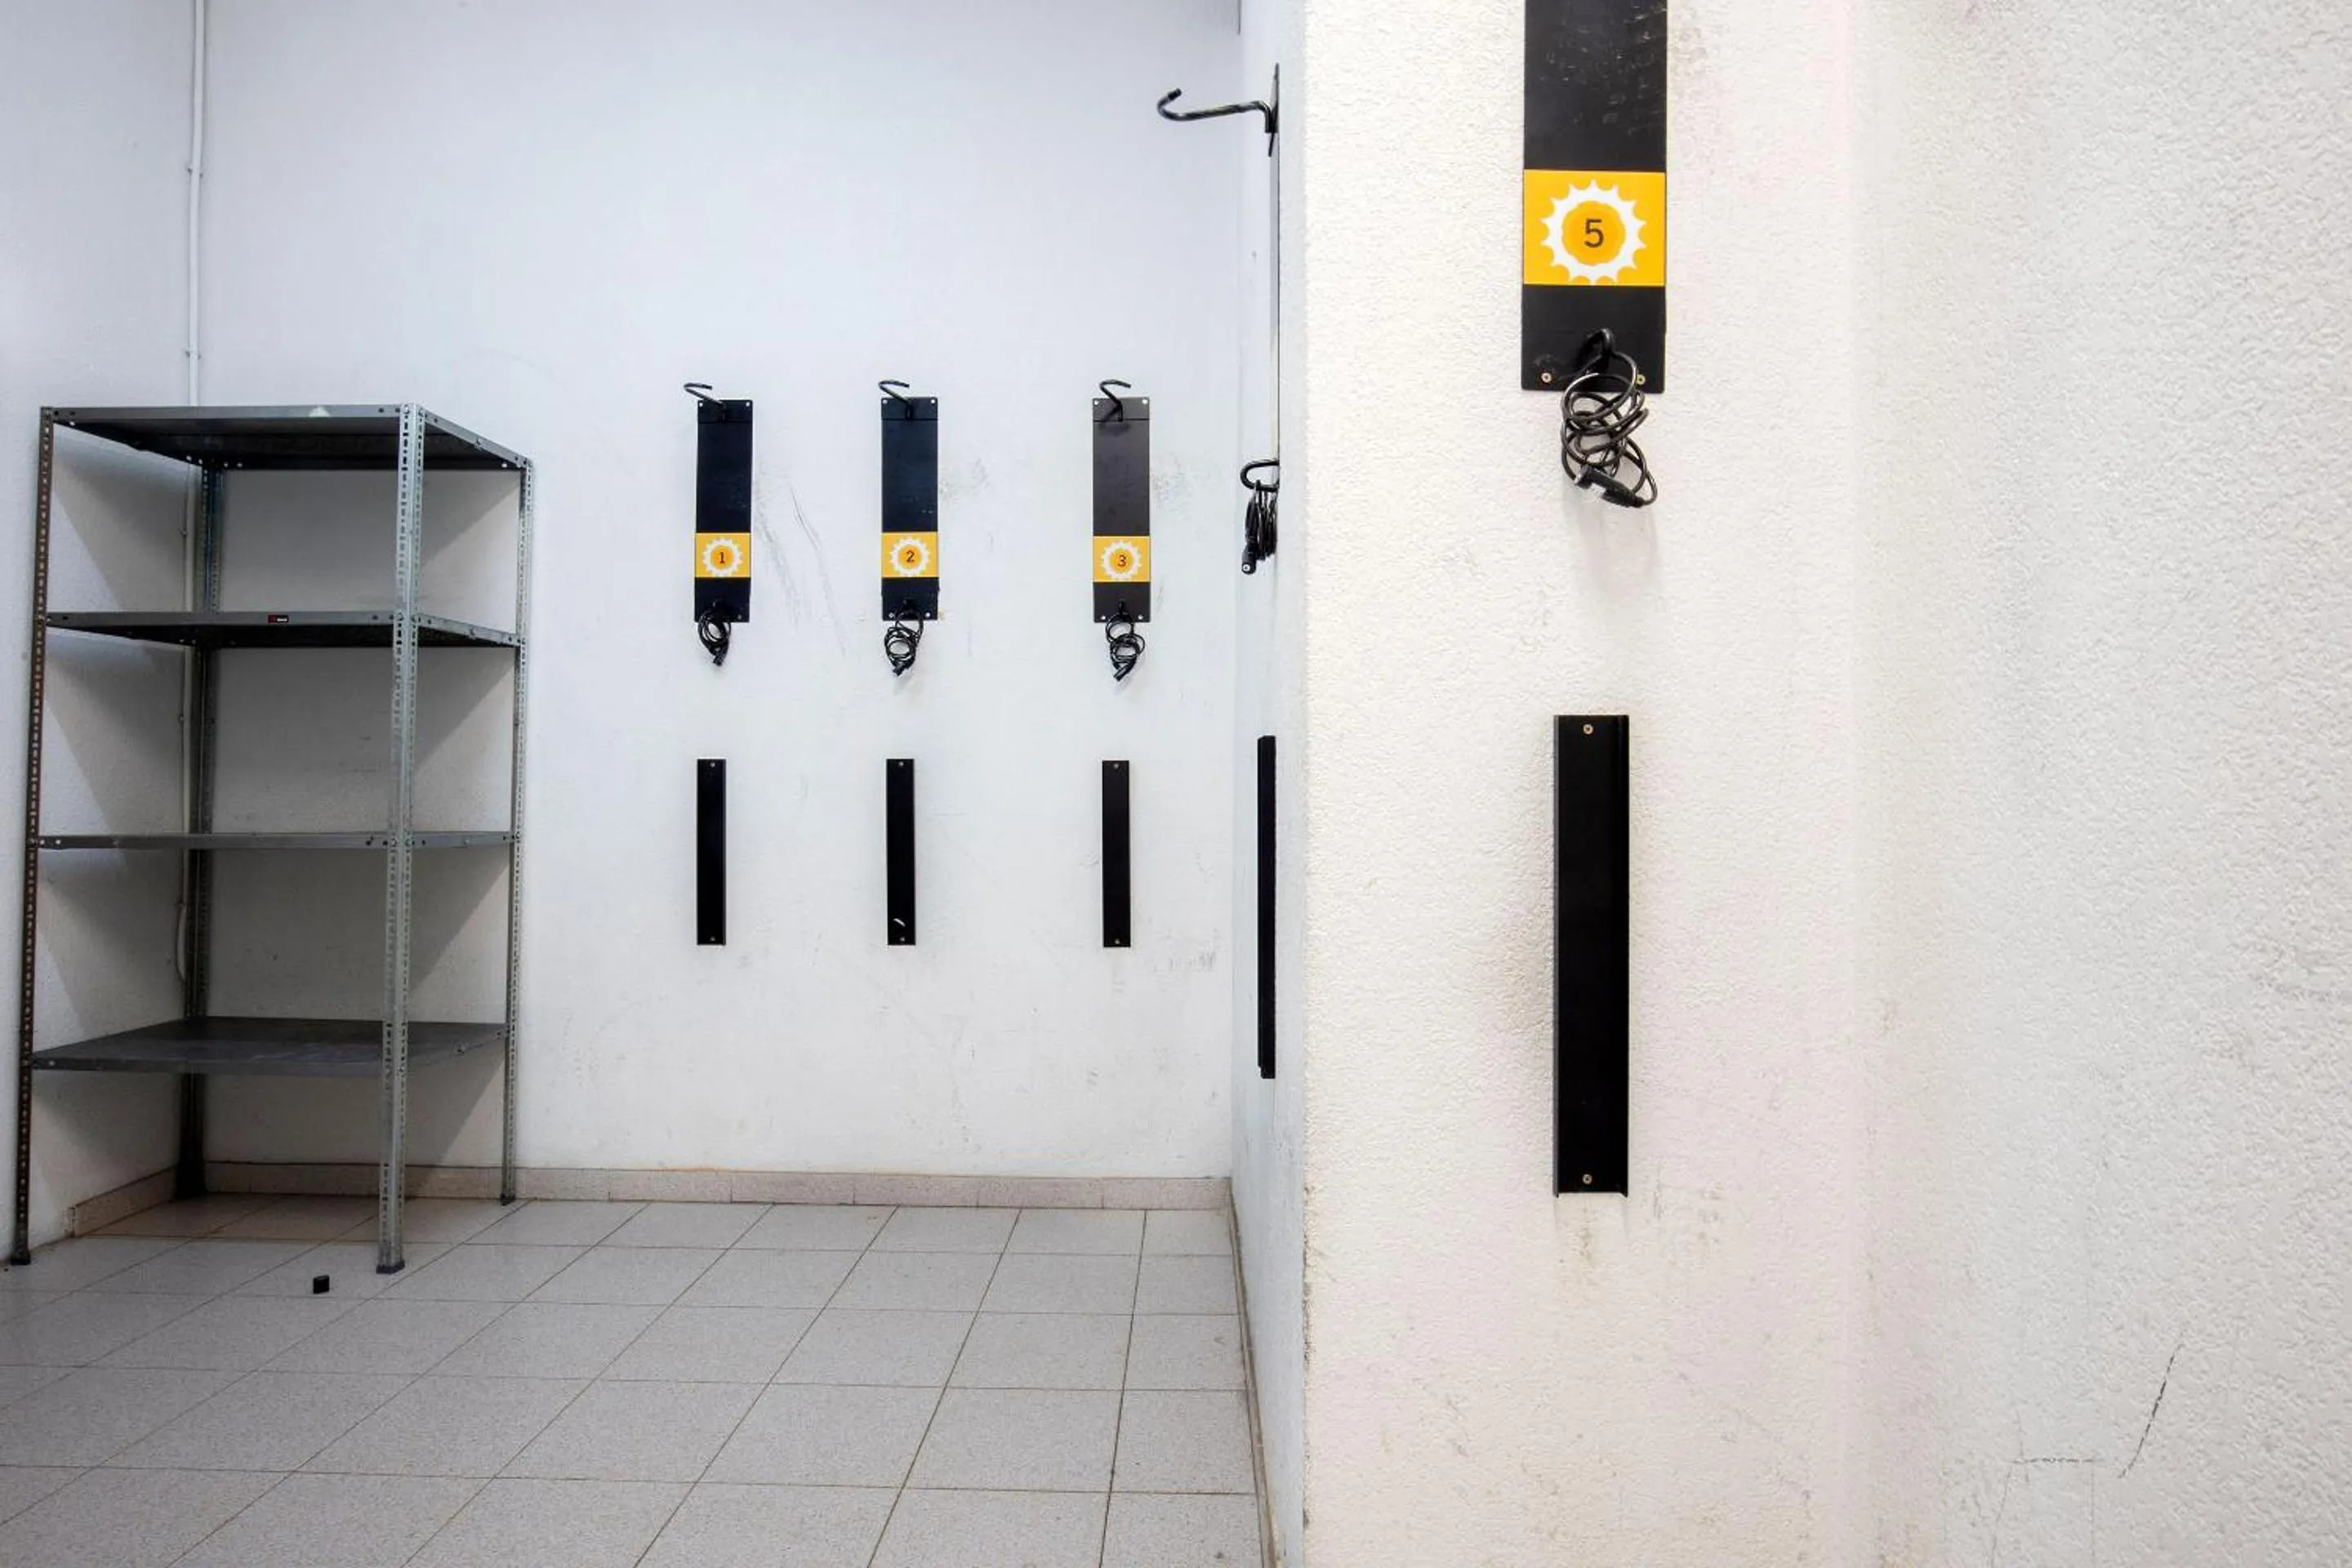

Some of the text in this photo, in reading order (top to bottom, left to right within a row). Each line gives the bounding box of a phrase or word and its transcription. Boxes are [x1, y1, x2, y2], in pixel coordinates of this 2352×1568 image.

[1584, 219, 1605, 248] 5
[719, 551, 725, 564] 1
[906, 550, 915, 563] 2
[1117, 555, 1127, 567] 3
